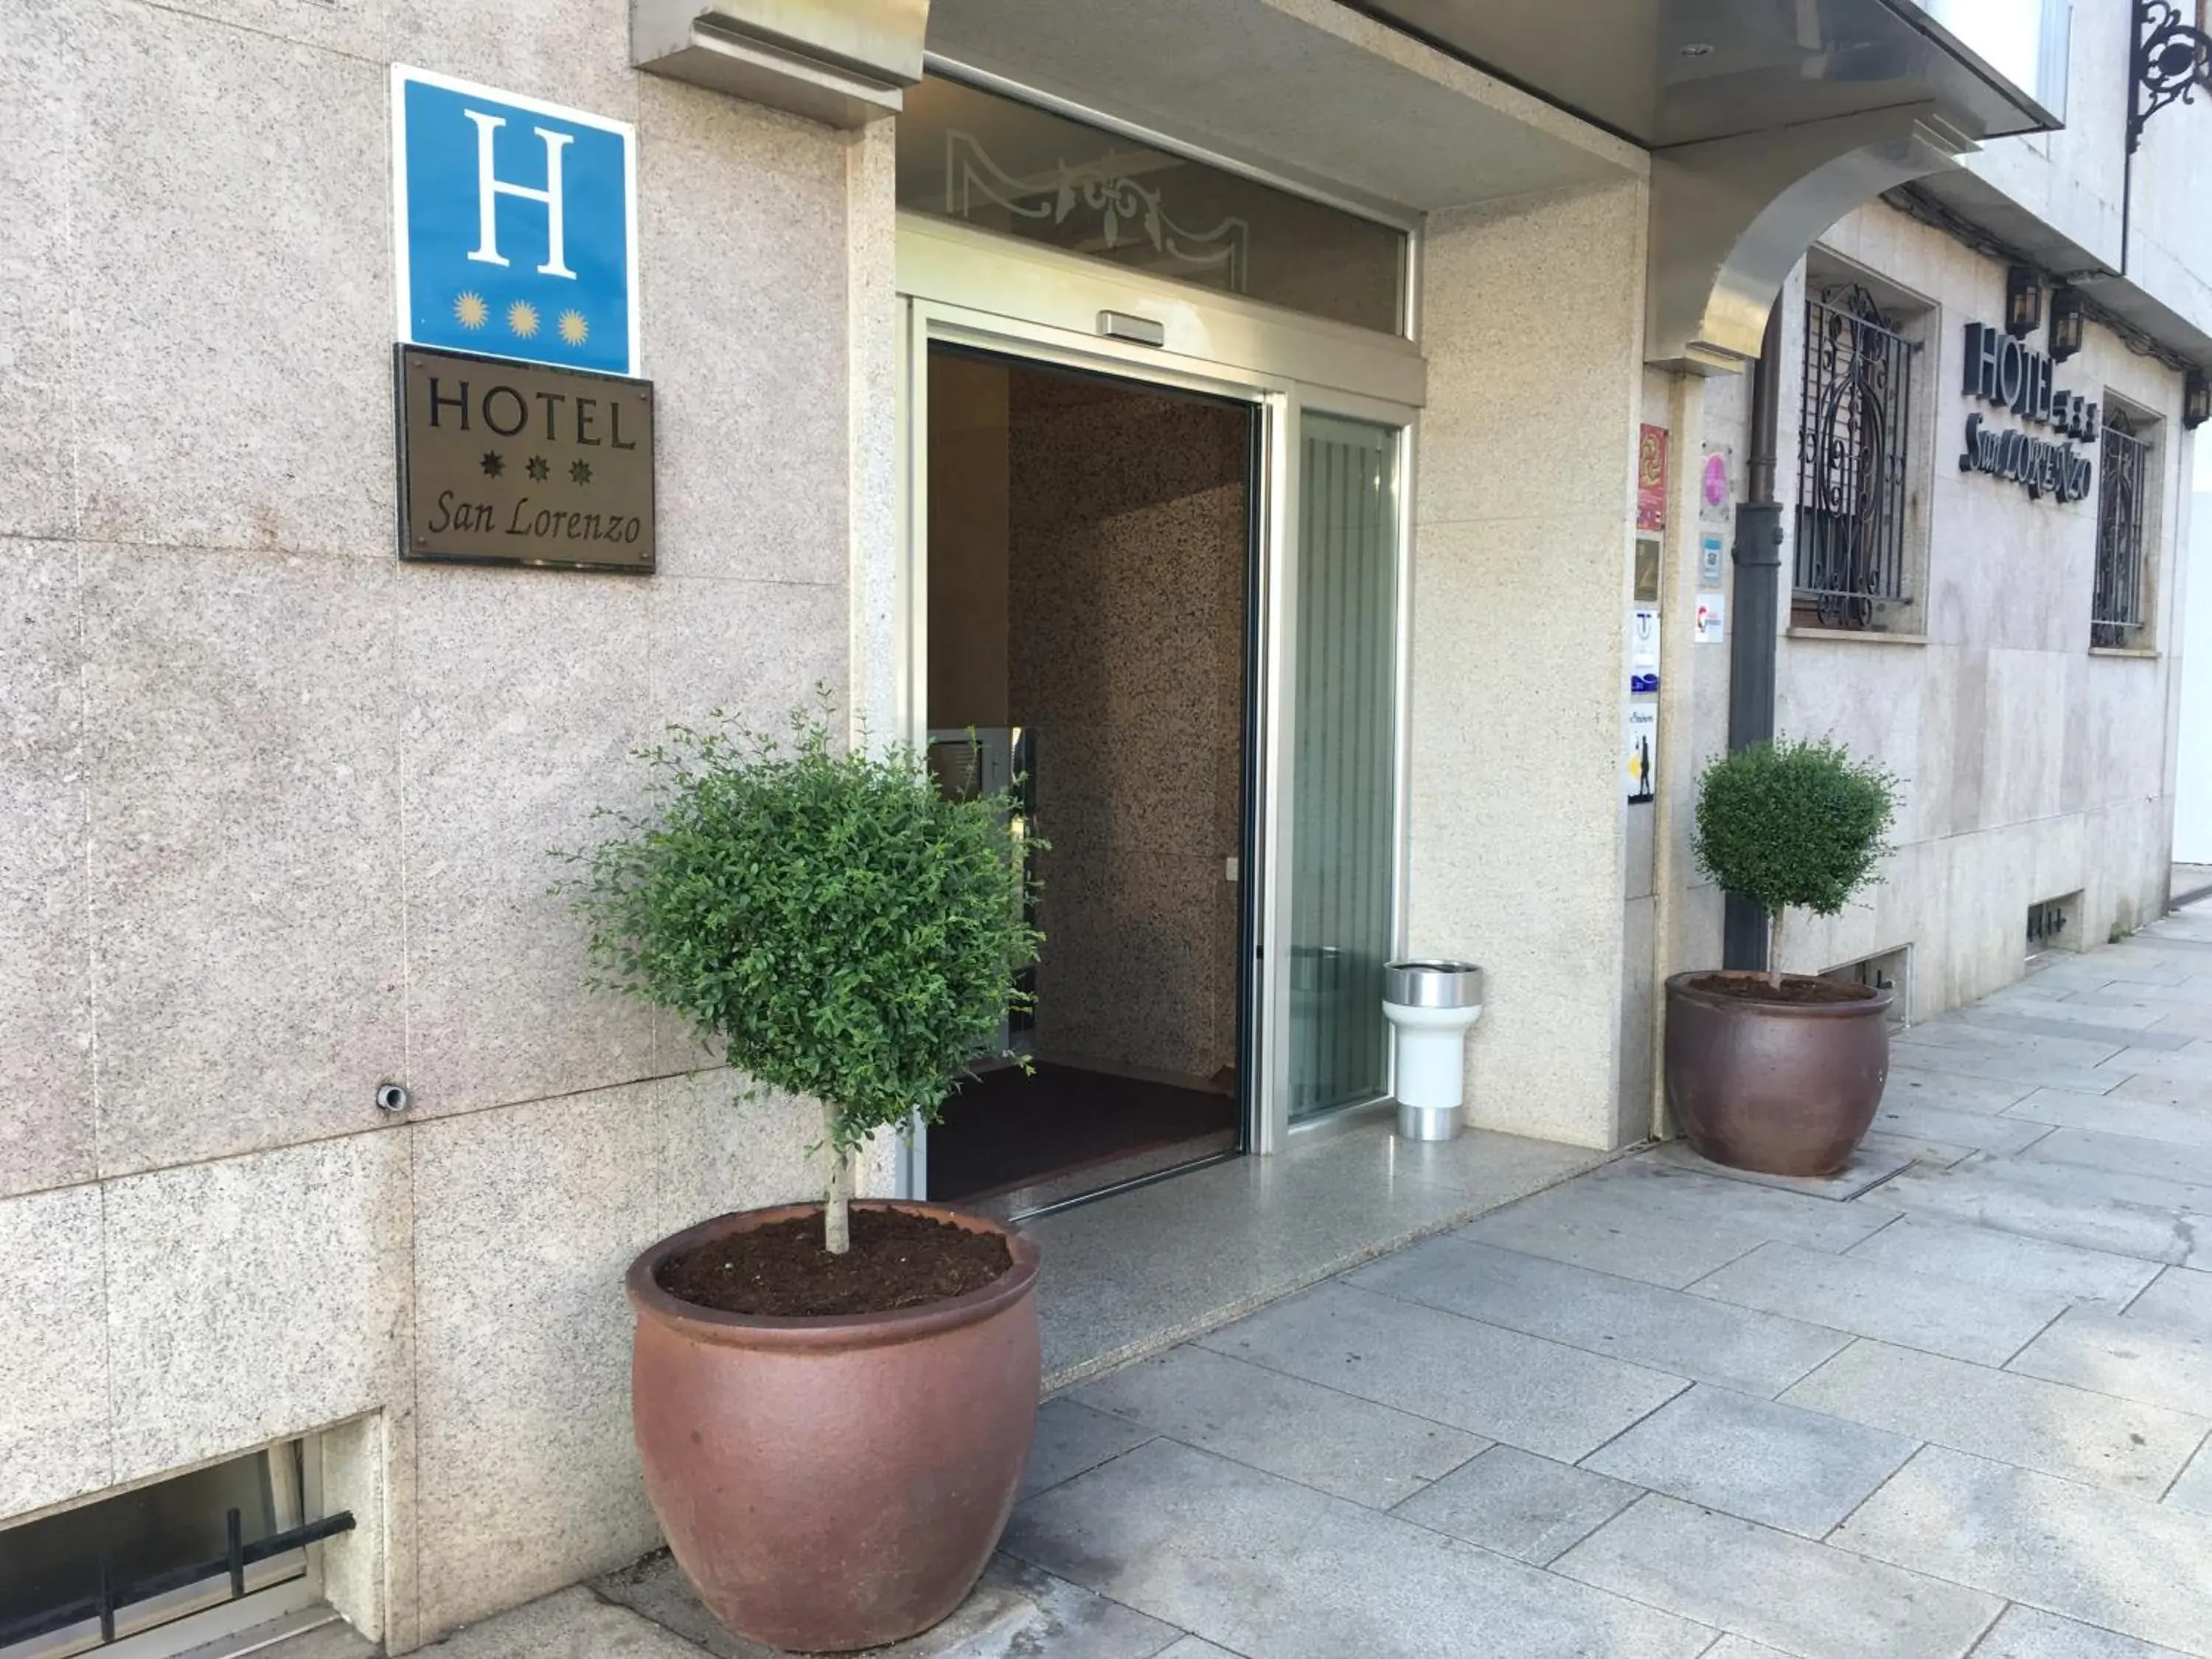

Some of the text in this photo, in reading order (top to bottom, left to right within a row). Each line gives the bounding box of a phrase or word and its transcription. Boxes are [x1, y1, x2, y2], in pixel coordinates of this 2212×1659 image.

[464, 108, 577, 280] H
[428, 377, 636, 450] HOTEL
[1962, 322, 2062, 428] HOTEL
[428, 490, 640, 543] San Lorenzo
